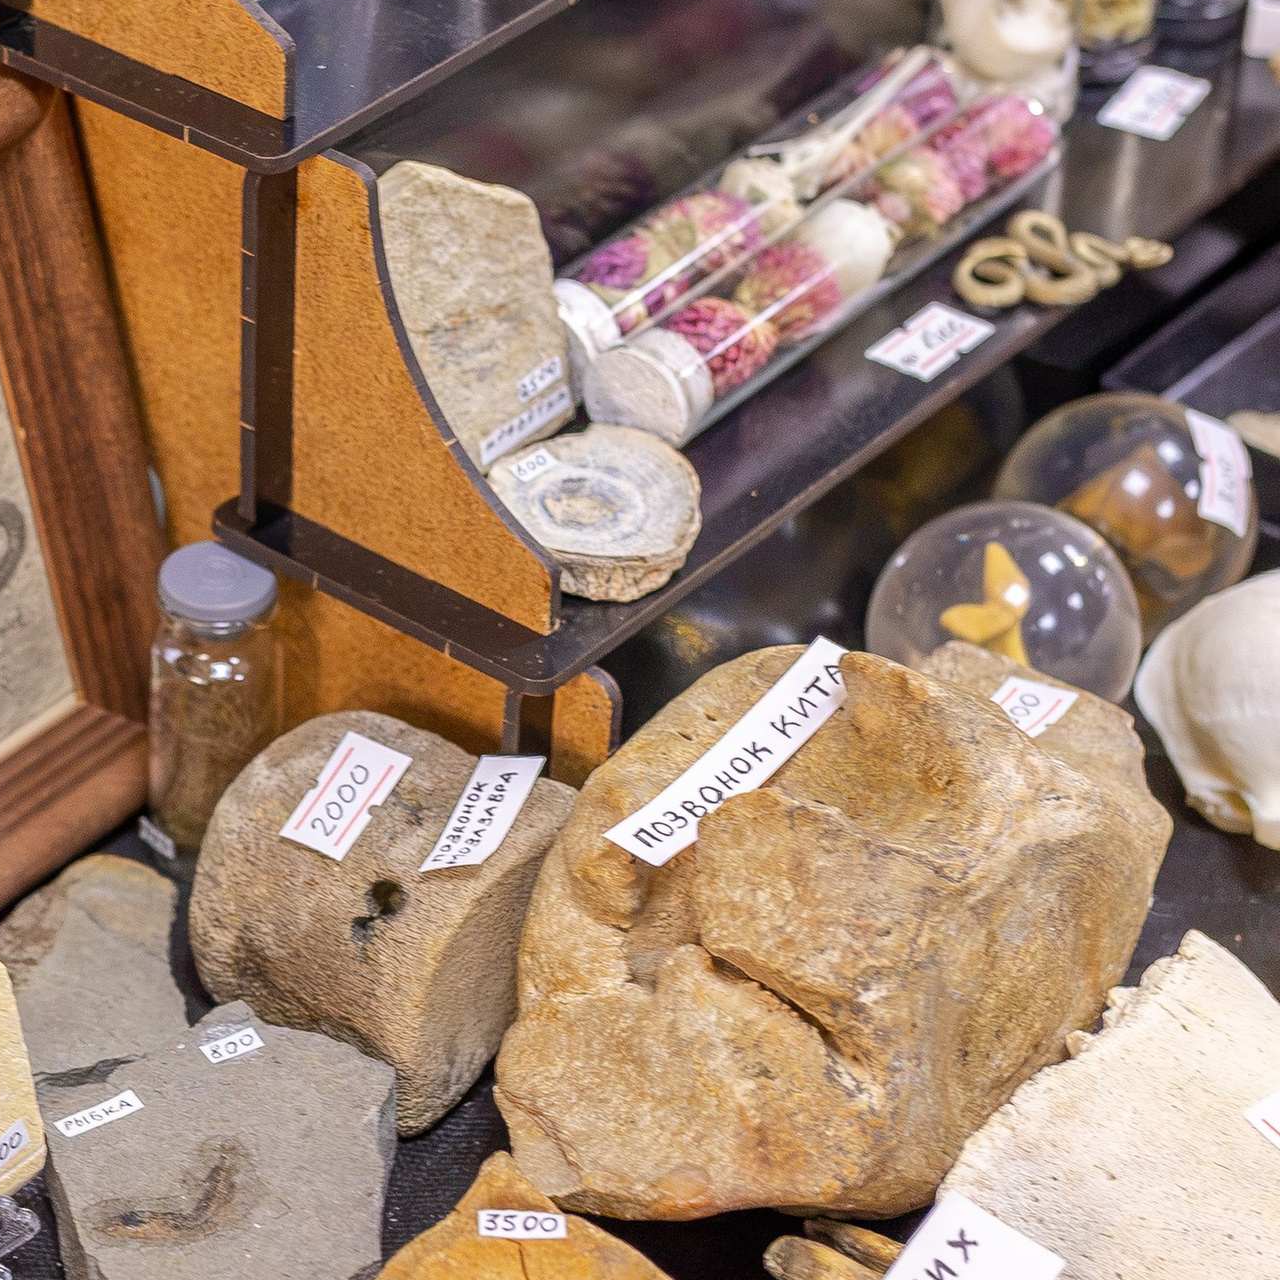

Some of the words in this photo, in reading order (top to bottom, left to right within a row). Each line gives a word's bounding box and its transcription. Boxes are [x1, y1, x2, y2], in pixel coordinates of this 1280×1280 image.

[1009, 693, 1040, 724] 00
[634, 741, 773, 848] ПОЗВОНОК
[770, 662, 843, 738] КИТА
[311, 764, 369, 836] 2000
[431, 780, 489, 863] ПОЗВОНОК
[211, 1034, 254, 1059] 800
[65, 1100, 133, 1131] РЫБКА
[484, 1213, 558, 1232] 3500
